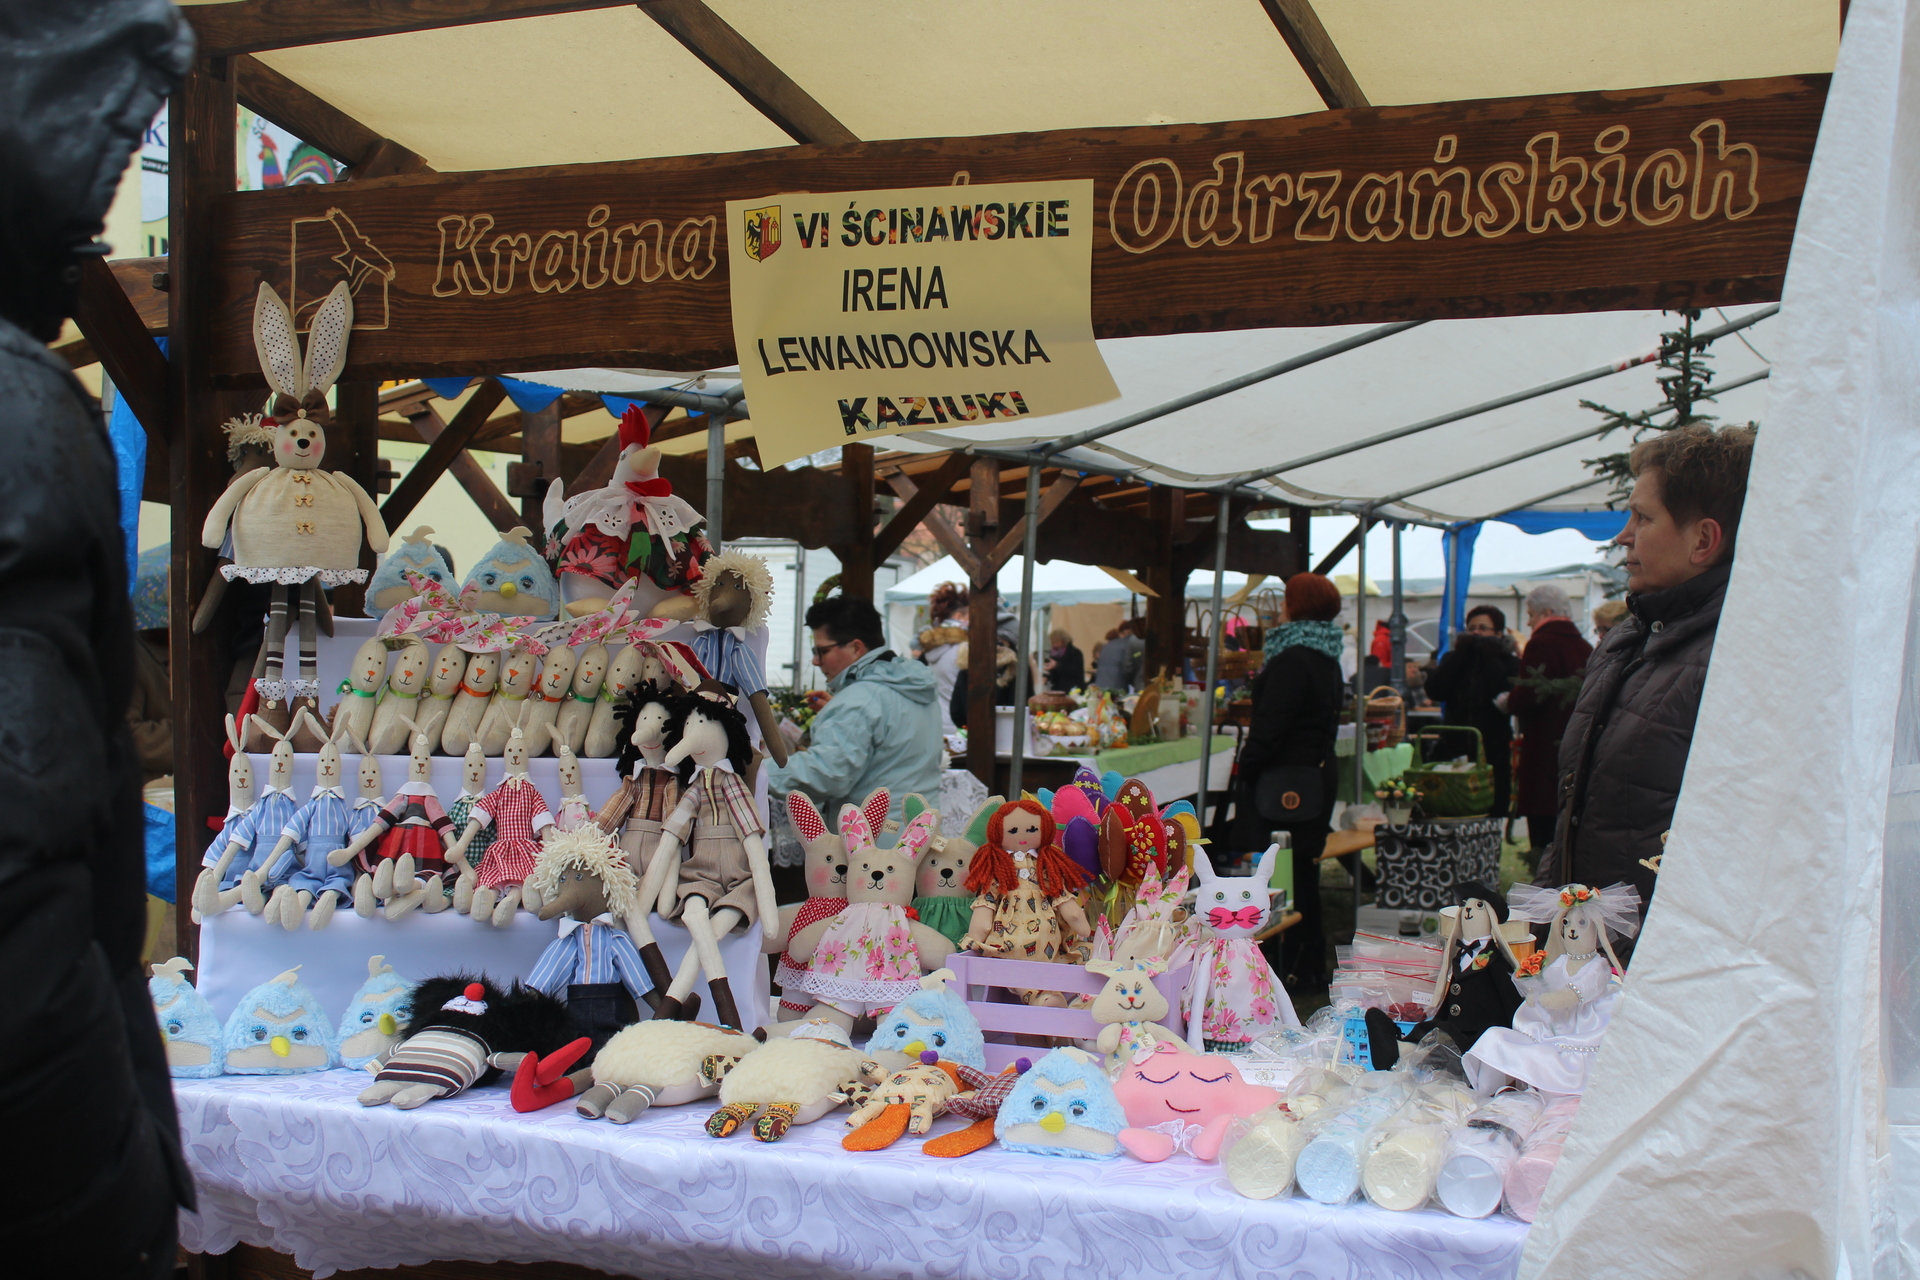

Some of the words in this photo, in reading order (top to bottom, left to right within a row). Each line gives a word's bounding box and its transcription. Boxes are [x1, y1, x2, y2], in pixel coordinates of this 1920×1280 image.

[432, 204, 717, 297] Kraina
[1109, 118, 1760, 253] Odrzańskich
[793, 211, 830, 249] VI
[841, 200, 1070, 246] ŚCINAWSKIE
[842, 265, 949, 312] IRENA
[757, 329, 1051, 377] LEWANDOWSKA
[837, 391, 1030, 436] KAZIUKI
